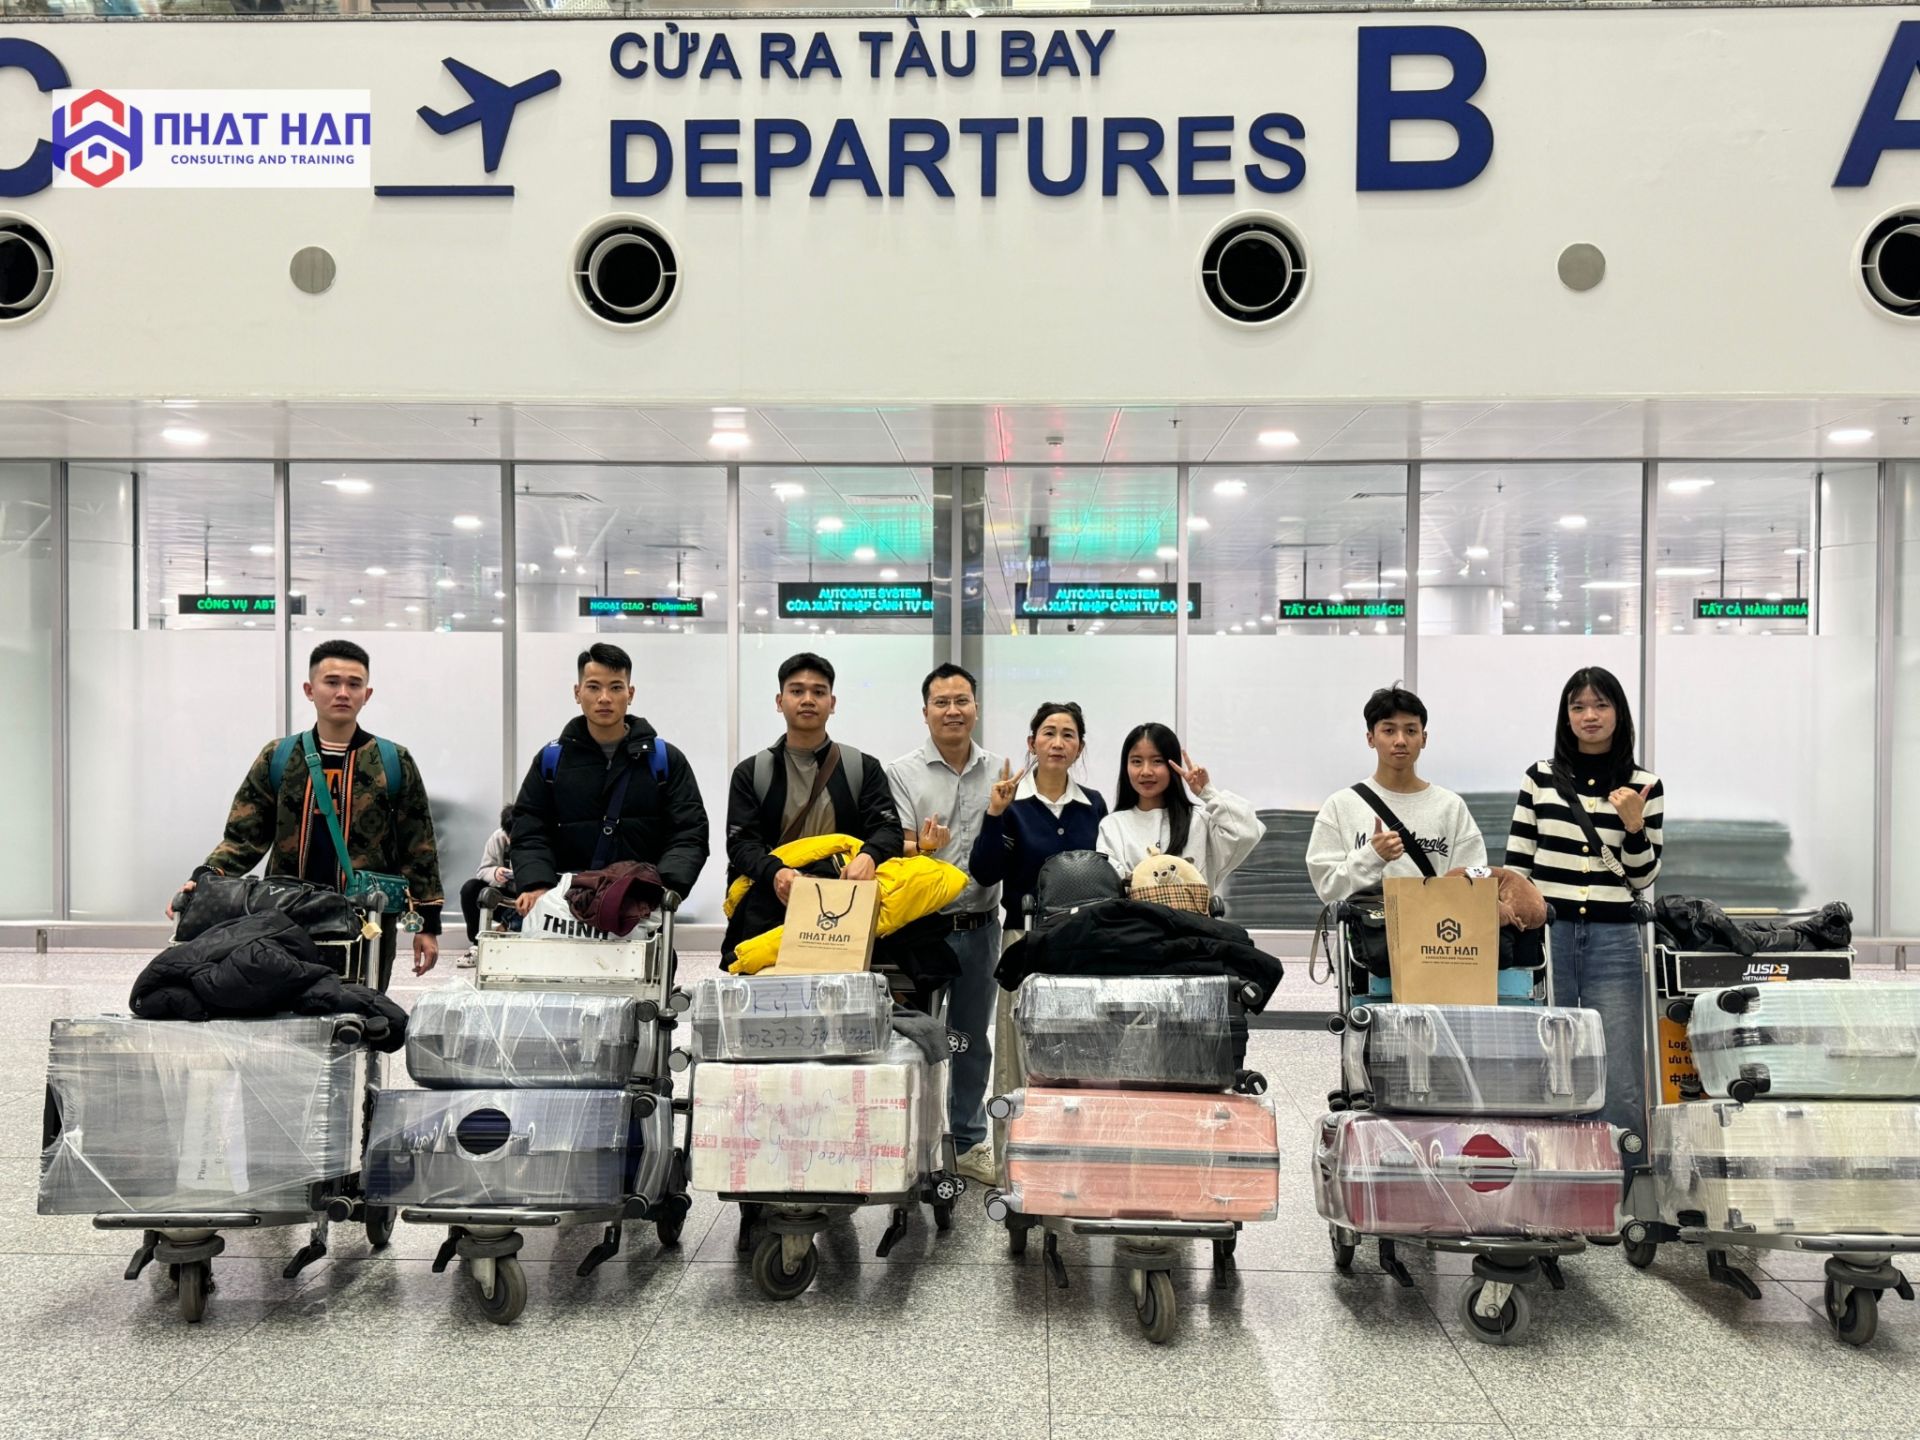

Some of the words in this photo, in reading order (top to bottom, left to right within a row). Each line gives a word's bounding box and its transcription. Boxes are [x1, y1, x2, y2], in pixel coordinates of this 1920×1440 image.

[610, 22, 742, 79] CỬA
[760, 31, 842, 79] RA
[859, 16, 976, 78] TÀU
[1001, 28, 1116, 77] BAY
[1356, 25, 1494, 191] B
[610, 112, 1307, 198] DEPARTURES
[819, 588, 877, 599] AUTOGATE
[878, 588, 922, 599] SYSTEM
[1056, 588, 1114, 599] AUTOGATE
[1115, 588, 1160, 599] SYSTEM
[197, 597, 230, 610] CÔNG
[232, 599, 248, 612] VỤ
[621, 601, 644, 611] GIAO
[1284, 602, 1306, 615] TẤT
[1308, 602, 1324, 615] CẢ
[1327, 602, 1360, 615] HÀNH
[1363, 602, 1404, 615] KHÁCH
[1701, 602, 1723, 615] TẤT
[1726, 602, 1742, 615] CẢ
[1745, 602, 1779, 615] HÀNH
